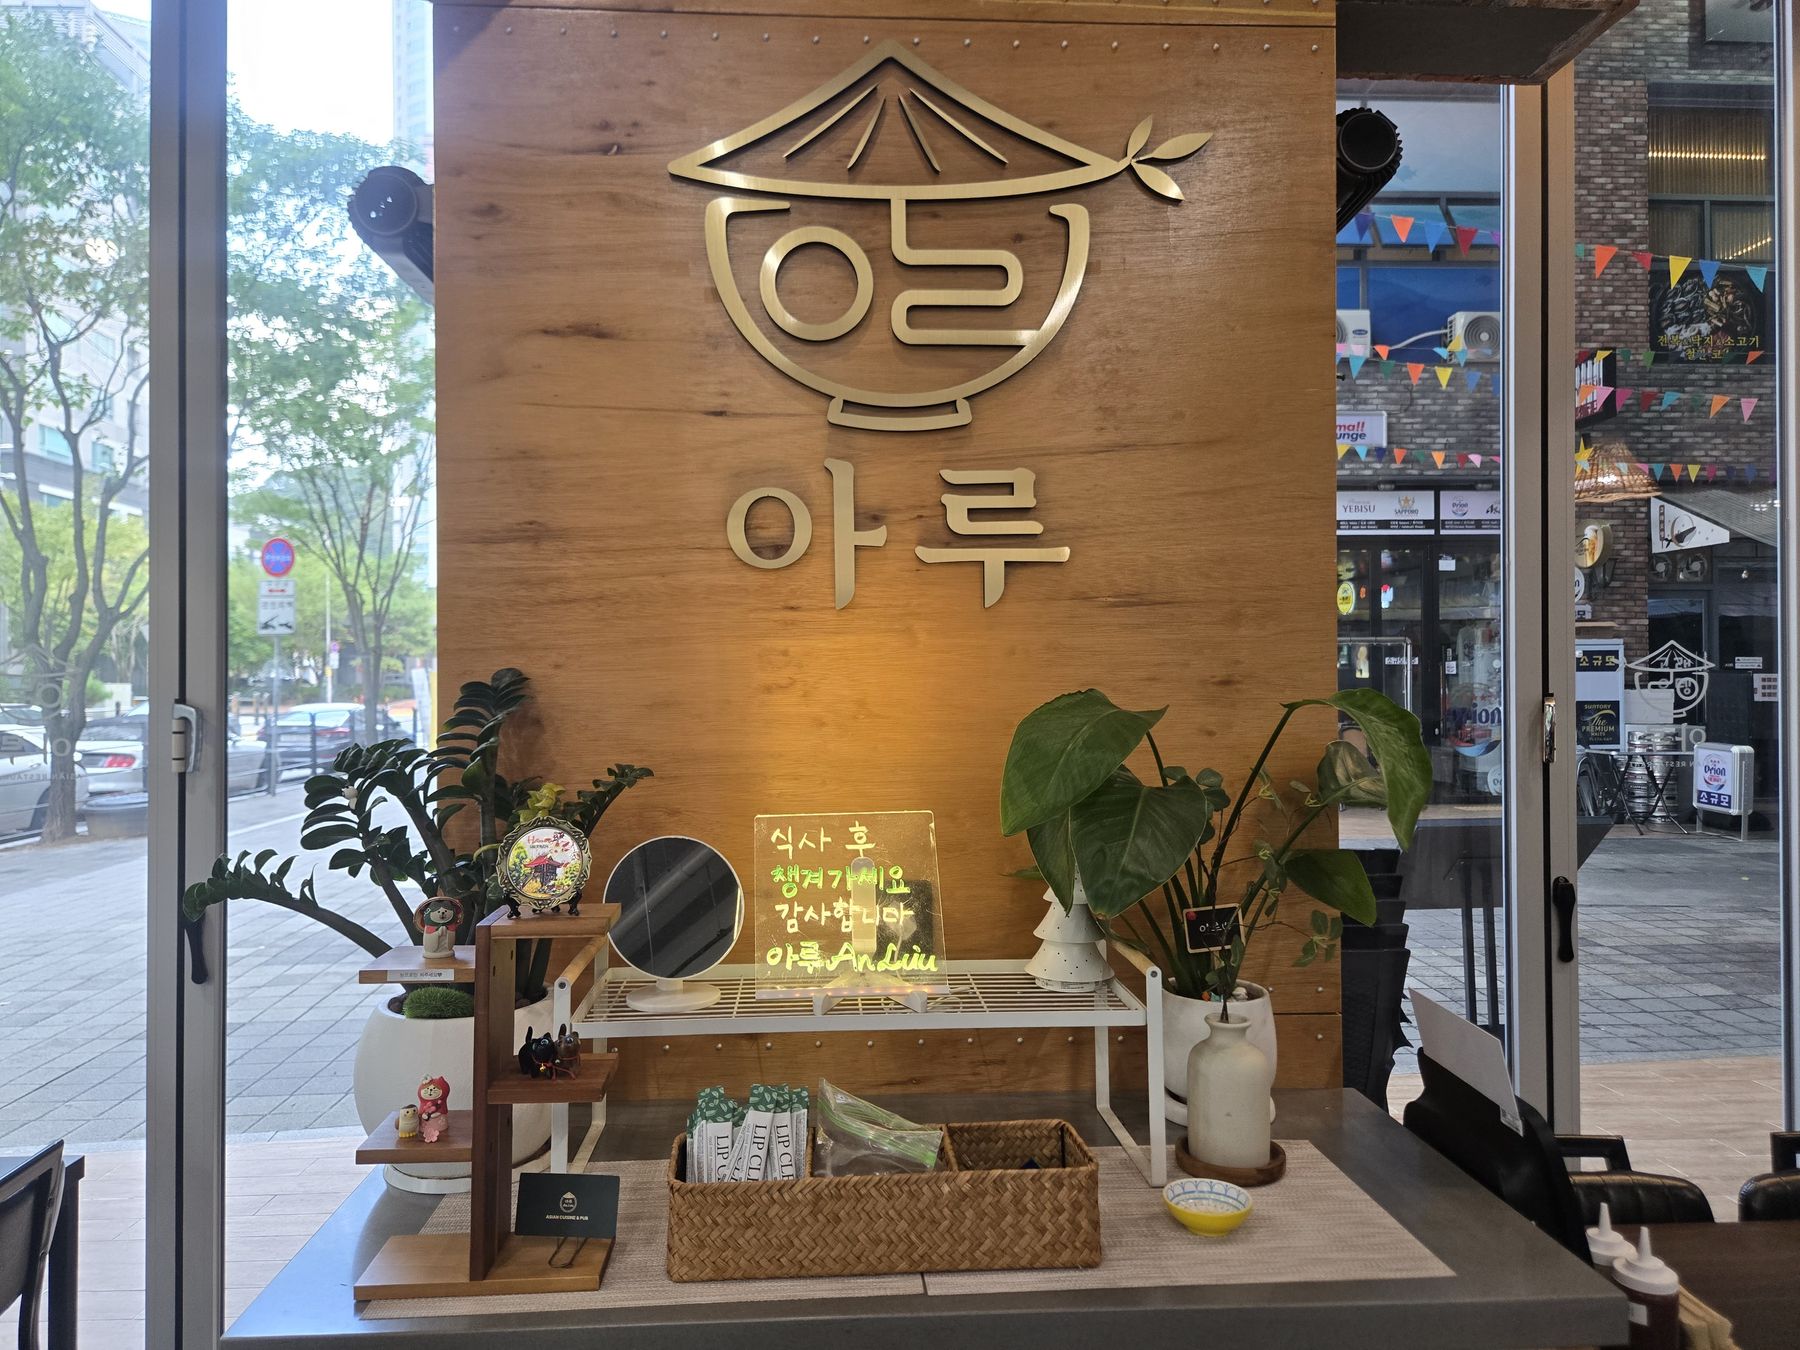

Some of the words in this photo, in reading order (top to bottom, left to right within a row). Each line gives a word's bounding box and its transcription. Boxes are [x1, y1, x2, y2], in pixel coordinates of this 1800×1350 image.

[1342, 504, 1376, 513] YEBISU
[726, 458, 1071, 611] 아루
[1581, 725, 1615, 733] PREMIUM
[1699, 791, 1730, 807] 소규모
[770, 826, 833, 860] 식사
[844, 820, 876, 859] 후
[770, 864, 911, 899] 챙겨가세요
[775, 897, 914, 933] 감사합니다
[766, 941, 825, 975] 아루
[716, 1135, 729, 1160] LIP
[752, 1124, 767, 1151] LIP
[776, 1124, 791, 1149] LIP
